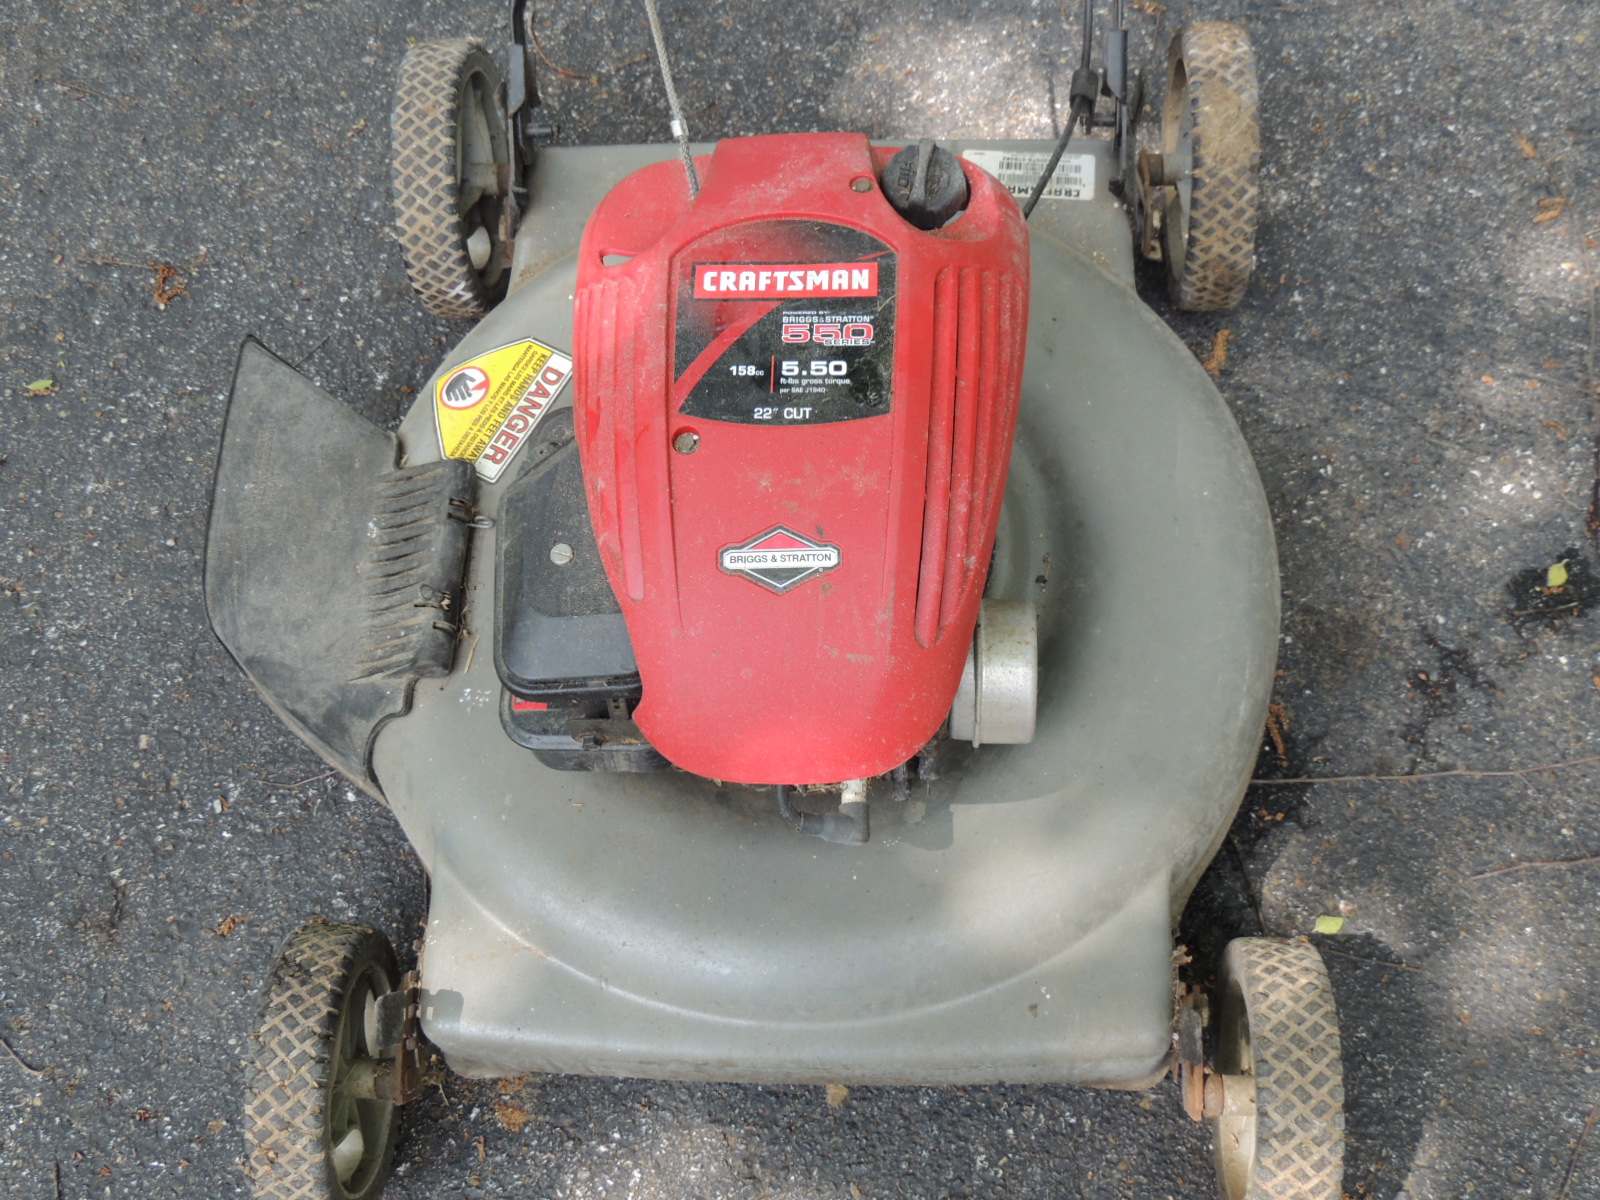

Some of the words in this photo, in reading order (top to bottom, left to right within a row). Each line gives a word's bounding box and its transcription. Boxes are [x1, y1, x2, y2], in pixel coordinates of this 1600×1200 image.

[703, 269, 869, 291] CRAFTSMAN
[782, 324, 874, 343] 550
[824, 339, 870, 347] SERIES
[530, 353, 549, 374] KEEP
[781, 361, 848, 376] 5.50
[509, 374, 534, 402] HANDS
[483, 366, 565, 465] DANGER
[497, 401, 513, 419] AND
[783, 407, 812, 419] CUT
[483, 420, 501, 439] FEET
[466, 438, 487, 463] AWAY
[729, 555, 768, 564] BRIGGS
[770, 554, 778, 563] &
[780, 553, 832, 562] STRATTON
